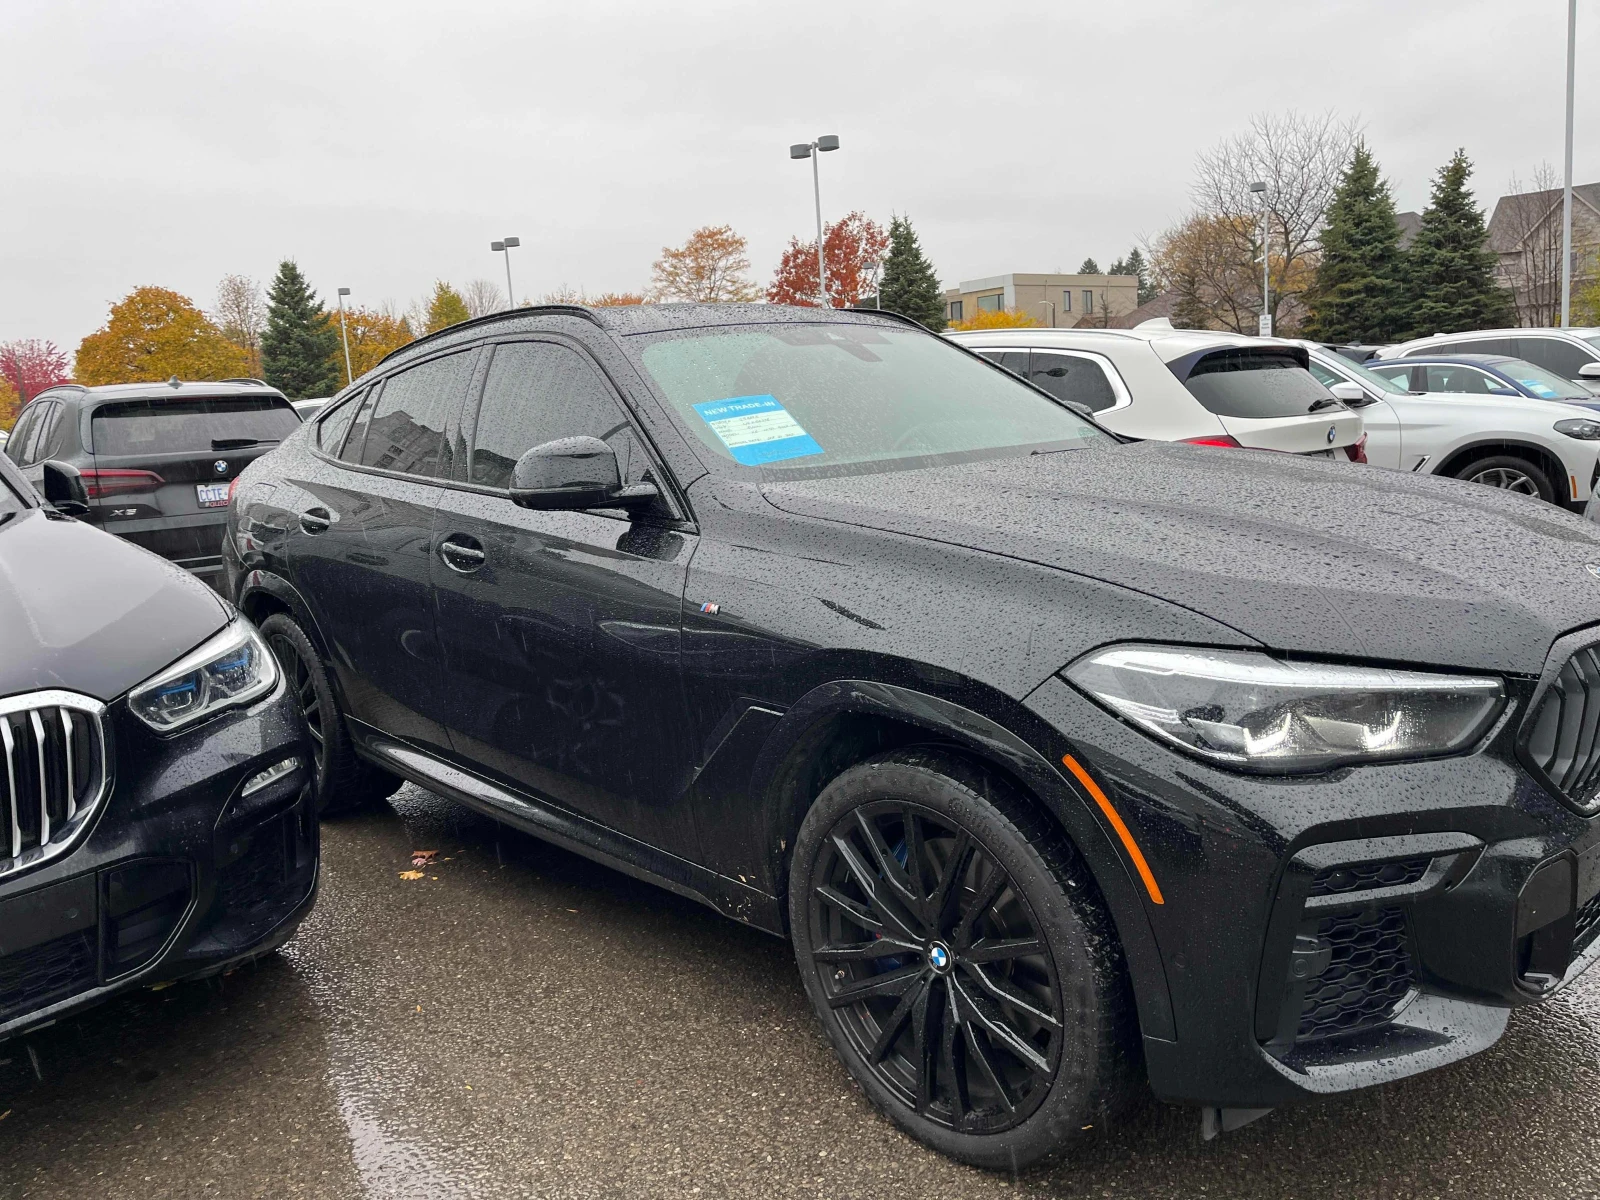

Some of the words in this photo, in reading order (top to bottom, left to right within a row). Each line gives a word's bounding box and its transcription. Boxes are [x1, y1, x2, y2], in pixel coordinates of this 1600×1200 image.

[704, 407, 728, 416] NEW
[729, 401, 775, 411] TRADE-IN
[110, 508, 137, 516] X5
